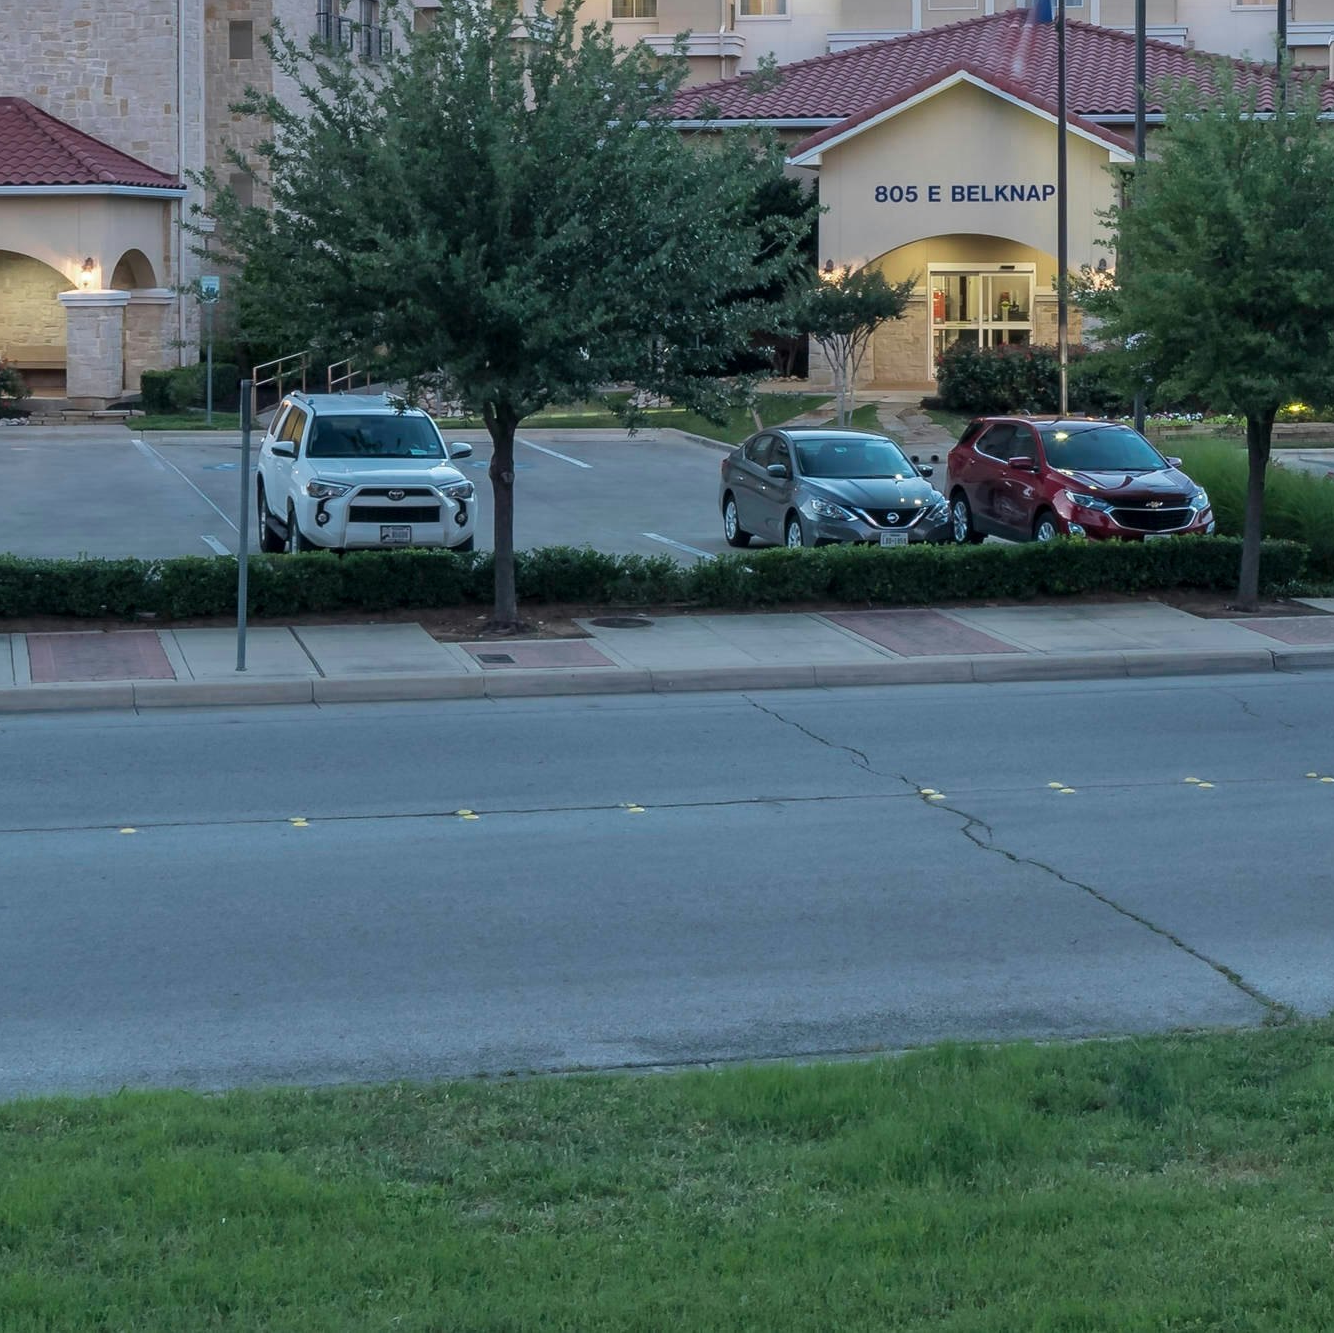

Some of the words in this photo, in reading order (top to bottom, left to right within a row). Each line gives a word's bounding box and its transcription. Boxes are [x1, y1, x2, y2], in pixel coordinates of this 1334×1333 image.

[874, 185, 919, 203] 805
[928, 185, 942, 203] E
[951, 184, 1056, 203] BELKNAP
